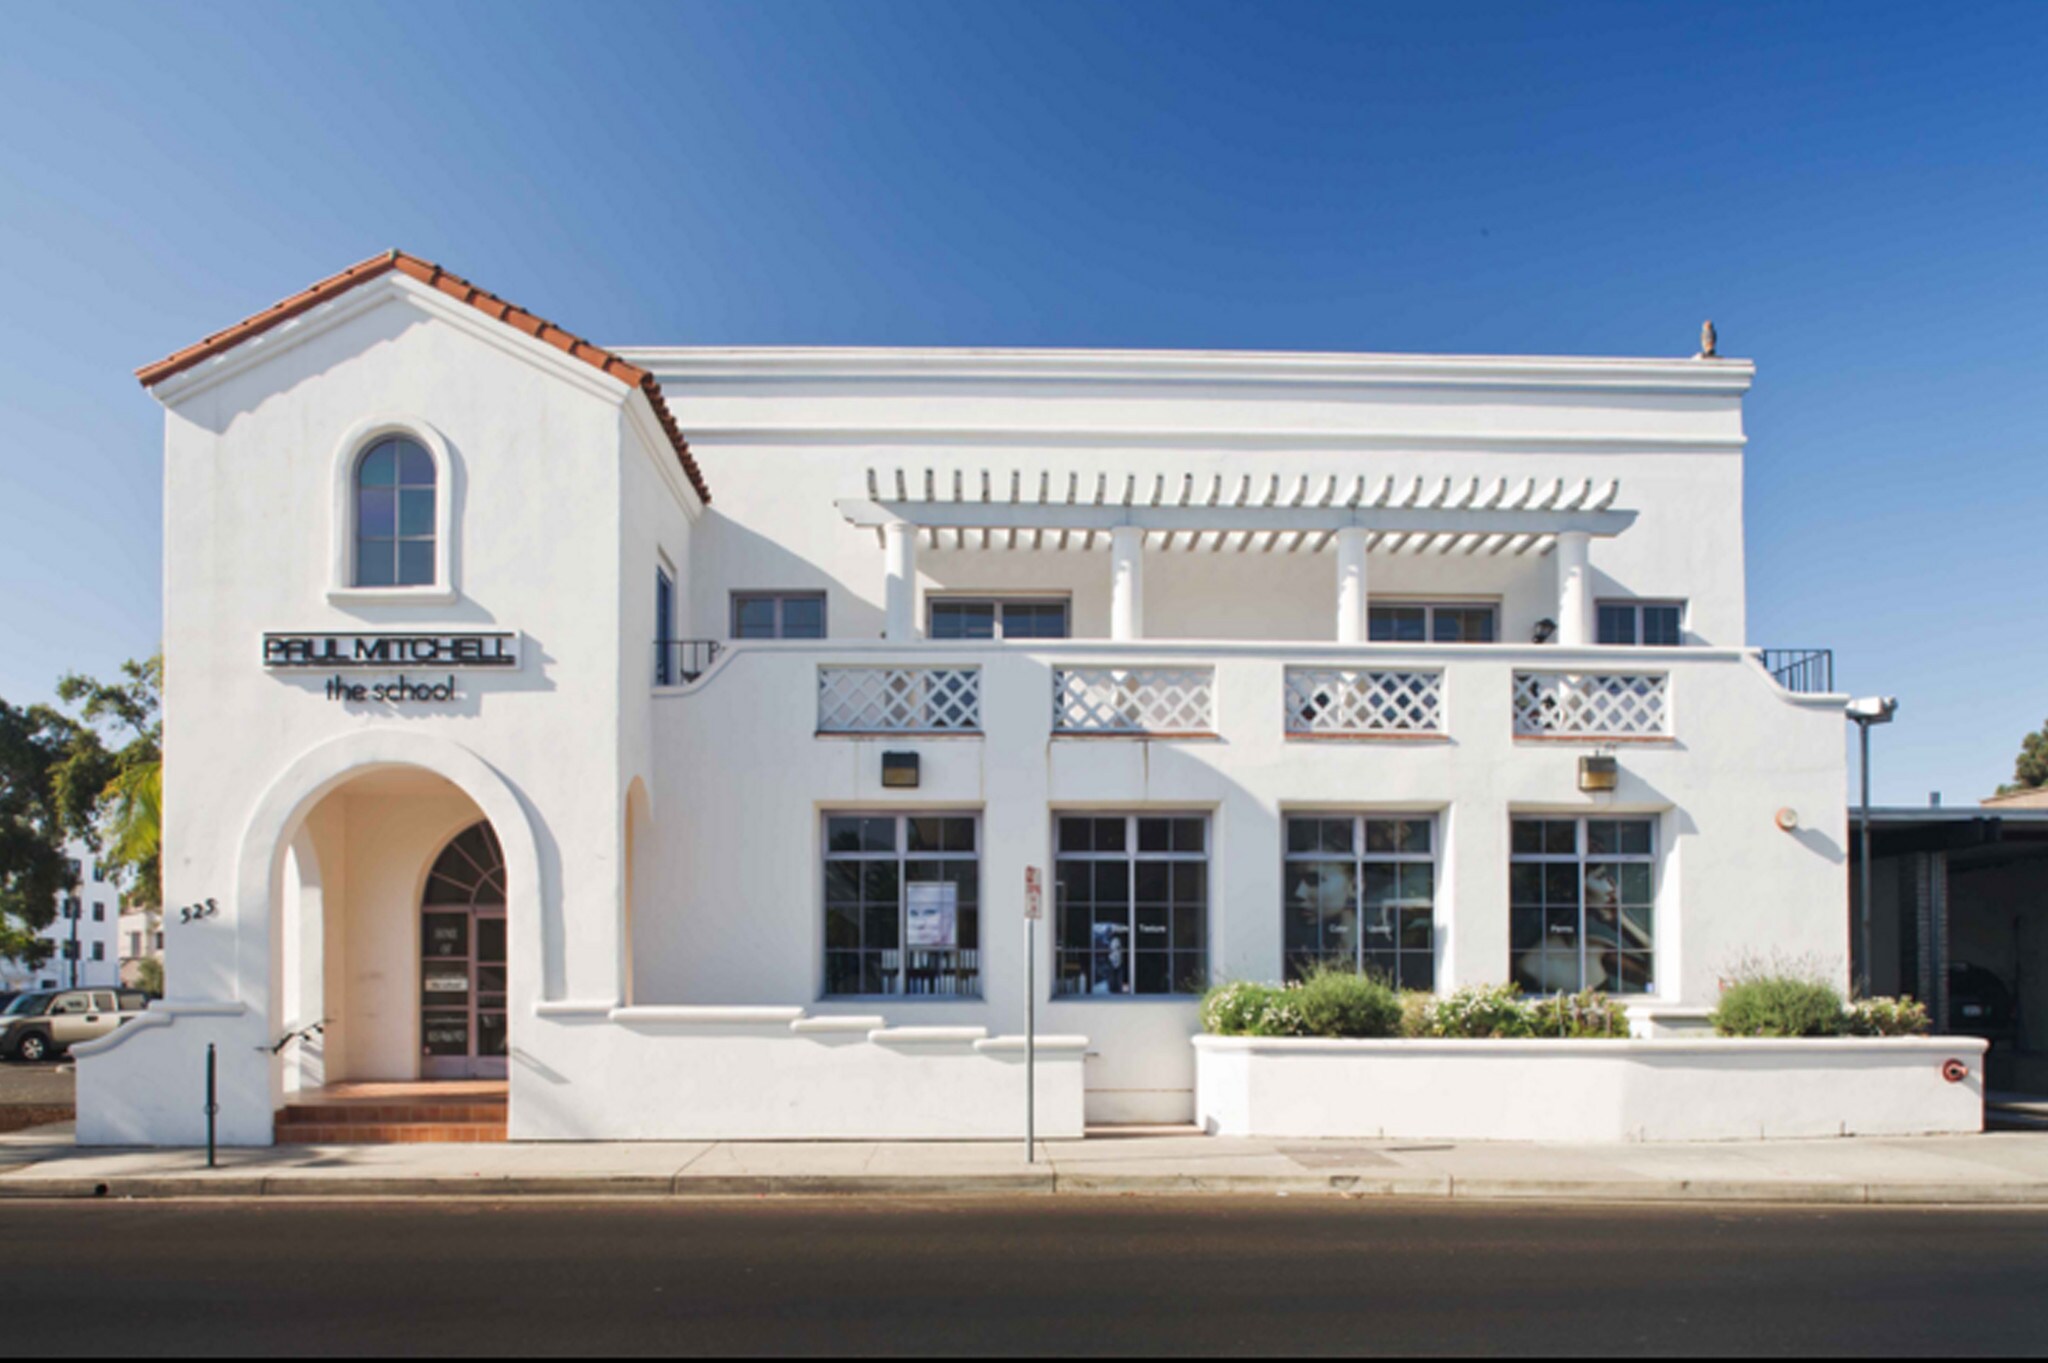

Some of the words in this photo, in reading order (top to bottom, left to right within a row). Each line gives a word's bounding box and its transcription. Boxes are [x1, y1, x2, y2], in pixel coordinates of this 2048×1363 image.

[263, 638, 350, 660] PAUL
[354, 637, 515, 661] MITCHELL
[327, 674, 367, 701] the
[372, 674, 456, 701] school
[181, 897, 216, 925] 525
